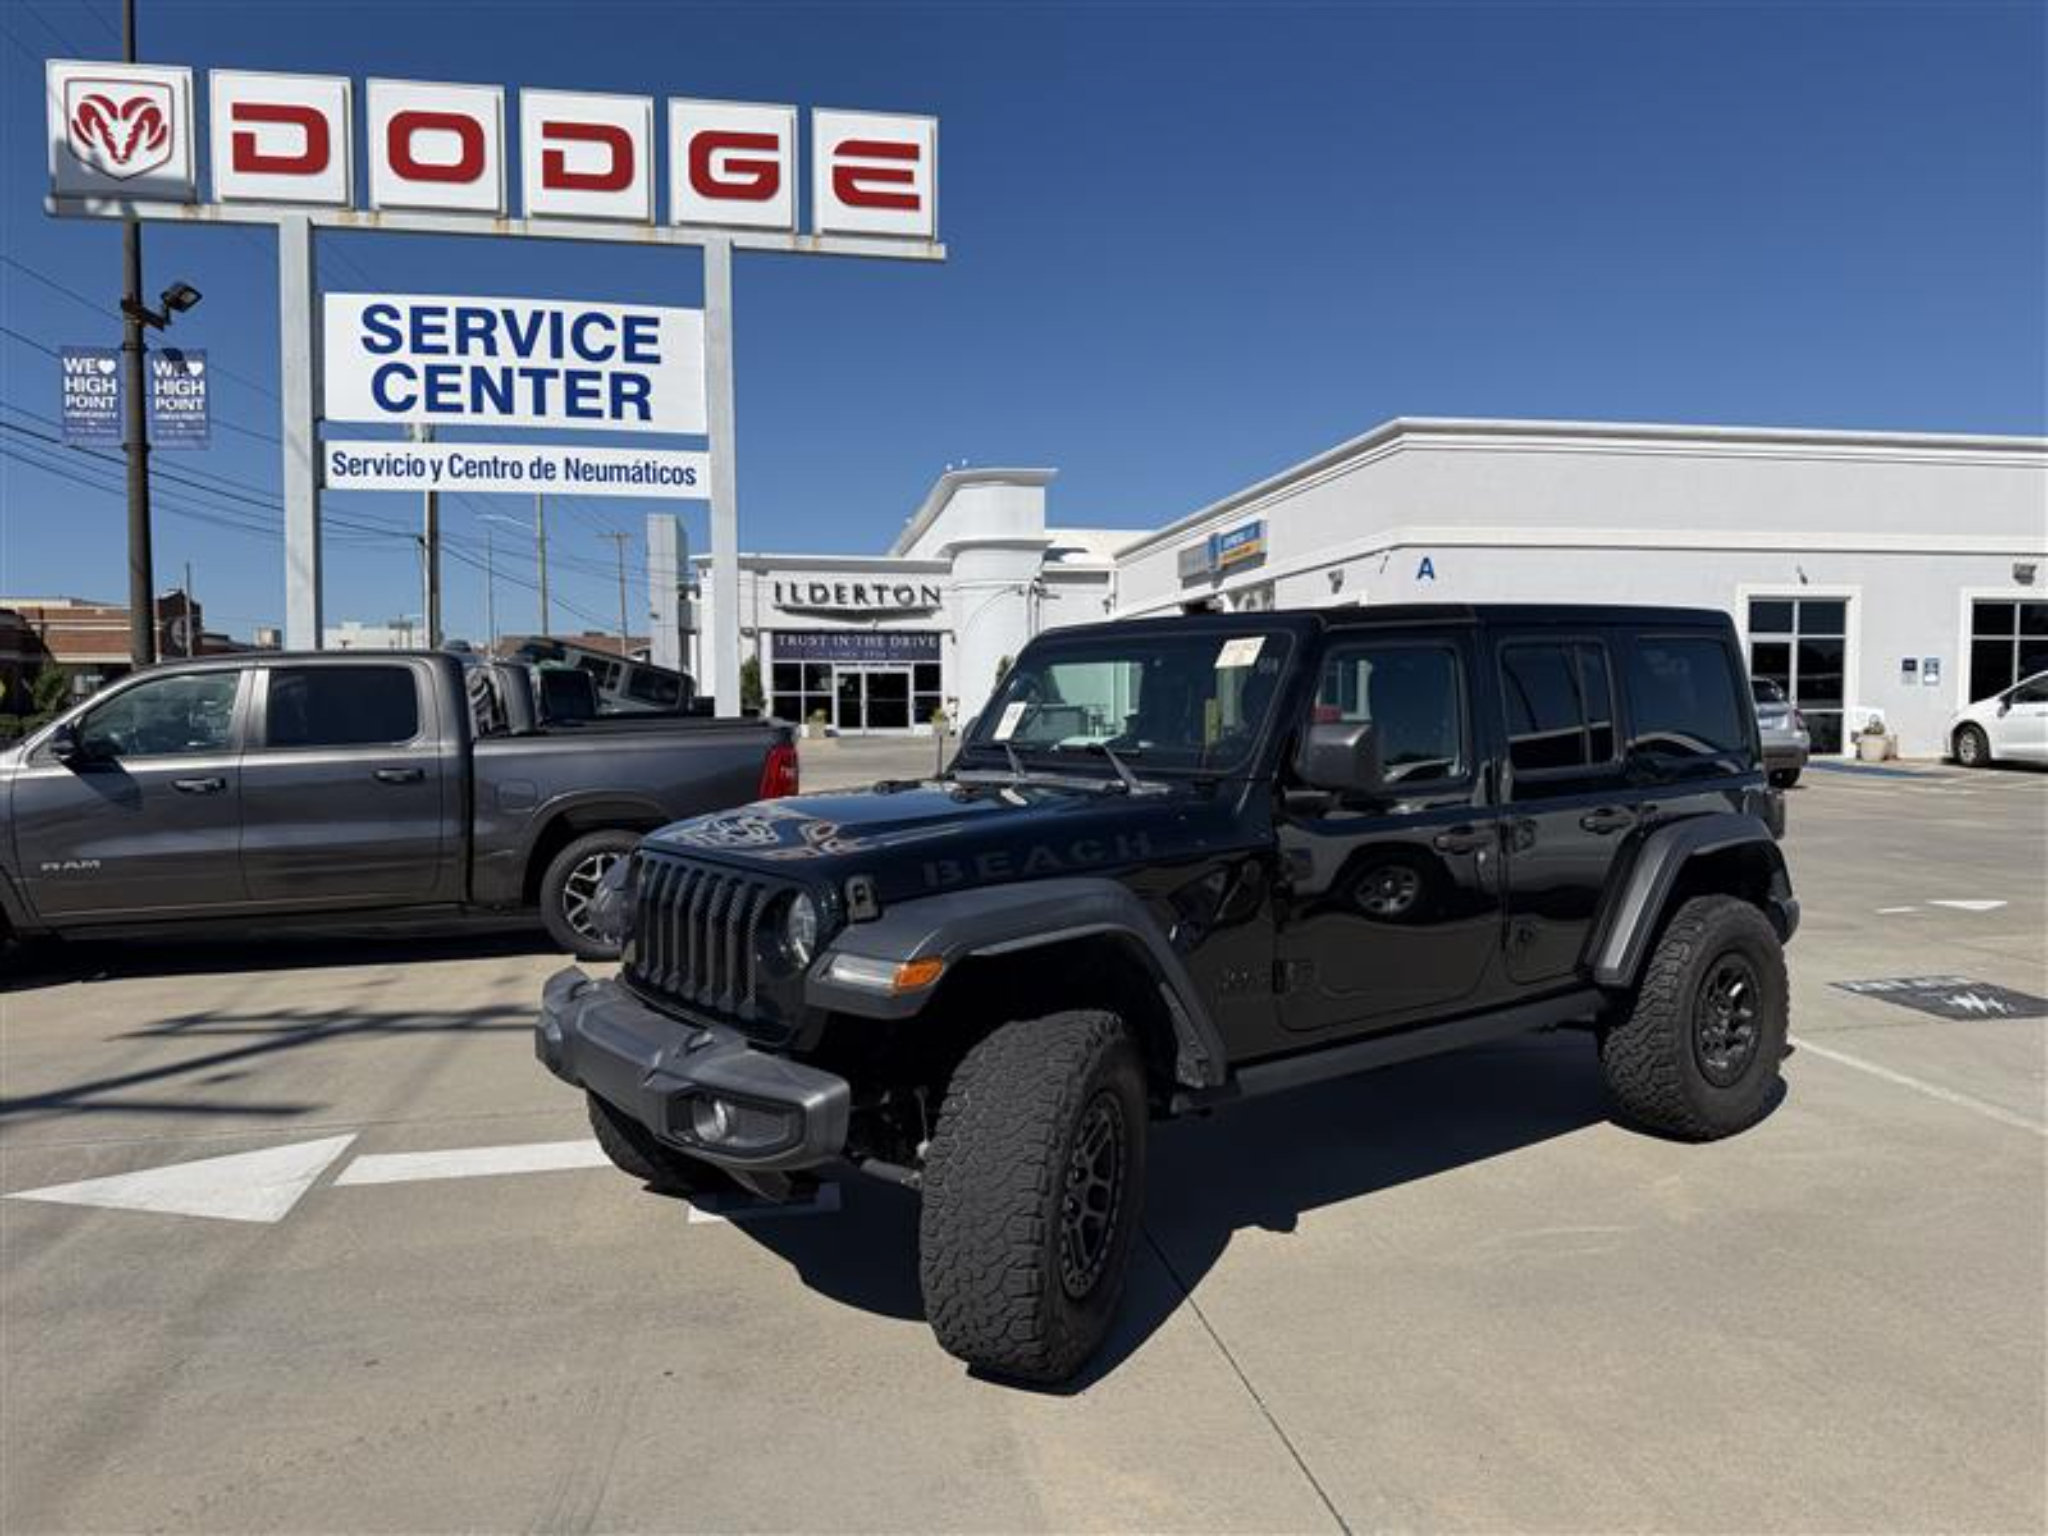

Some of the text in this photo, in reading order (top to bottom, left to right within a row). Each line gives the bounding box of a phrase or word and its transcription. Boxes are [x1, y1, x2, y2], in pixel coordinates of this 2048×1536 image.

[232, 102, 921, 212] DODGE
[360, 303, 662, 365] SERVICE
[63, 357, 96, 374] WE
[64, 376, 117, 395] HIGH
[155, 379, 206, 396] HIGH
[371, 362, 654, 422] CENTER
[65, 394, 117, 409] POINT
[155, 397, 206, 411] POINT
[331, 450, 698, 487] Servicio y Centro de Neumáticos
[1416, 557, 1436, 580] A
[774, 581, 942, 606] ILDERTON
[779, 634, 938, 649] TRUST IN THE DRIVE
[41, 860, 101, 873] RAM
[922, 830, 1152, 888] BEACH
